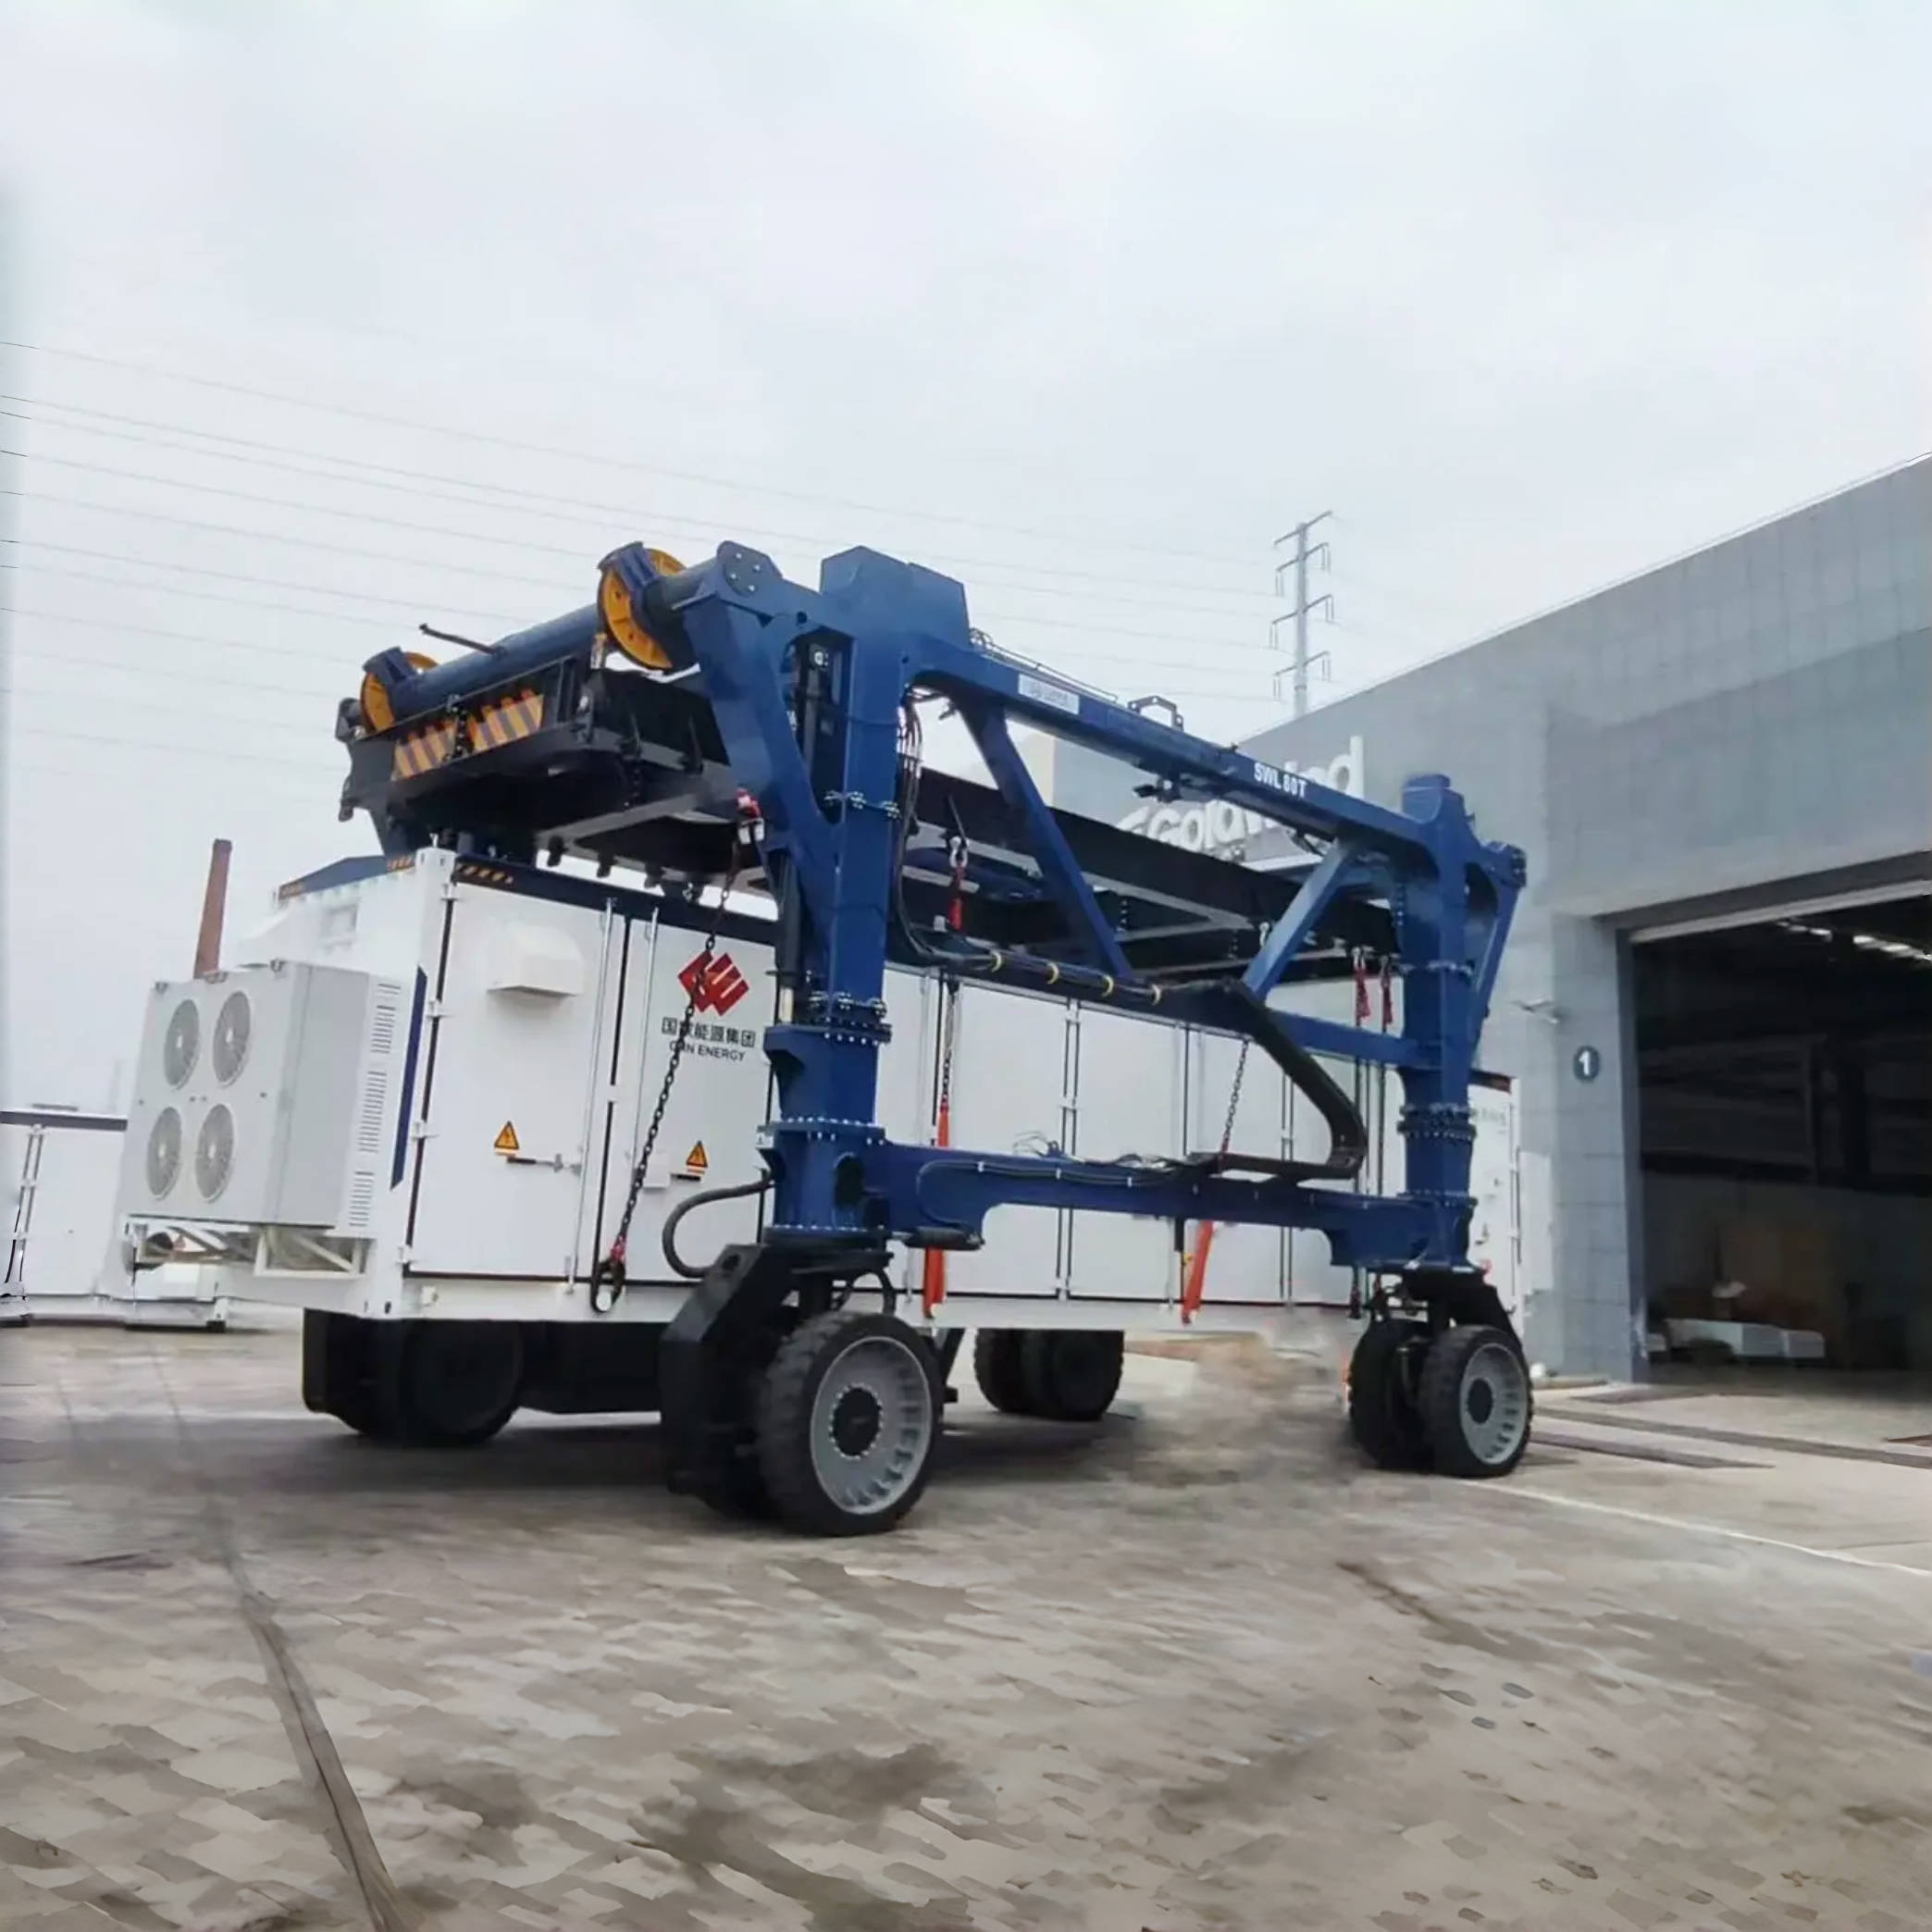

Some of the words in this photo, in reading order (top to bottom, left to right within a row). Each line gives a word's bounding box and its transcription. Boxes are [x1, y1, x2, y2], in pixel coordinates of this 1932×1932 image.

[1254, 762, 1282, 789] SWL
[698, 1044, 746, 1061] ENERGY
[1579, 1050, 1591, 1075] 1
